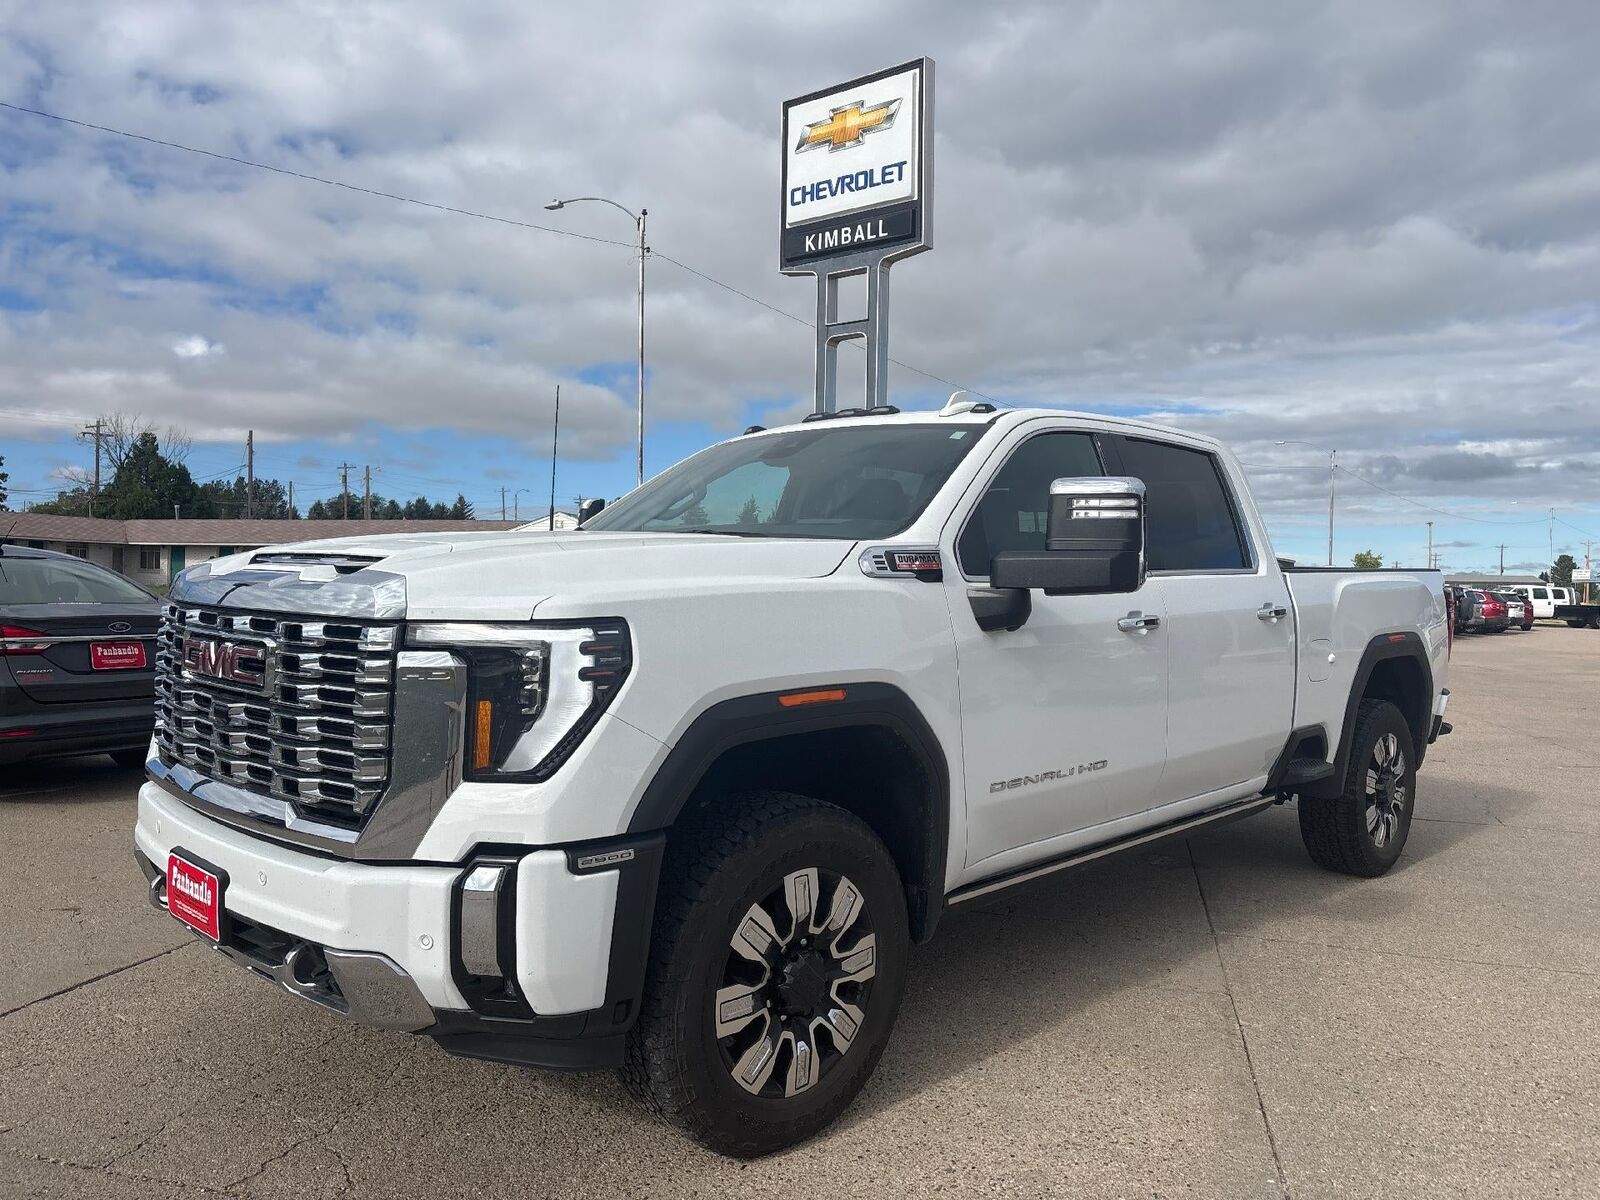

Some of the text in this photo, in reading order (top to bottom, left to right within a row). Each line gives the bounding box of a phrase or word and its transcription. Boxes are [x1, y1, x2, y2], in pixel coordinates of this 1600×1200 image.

[791, 161, 907, 206] CHEVROLET
[805, 220, 888, 252] KIMBALL
[897, 554, 937, 563] DURAMAX
[183, 640, 264, 685] GMC
[990, 760, 1108, 793] DENALI HD
[579, 850, 633, 868] 2500
[172, 866, 212, 906] Panhandle
